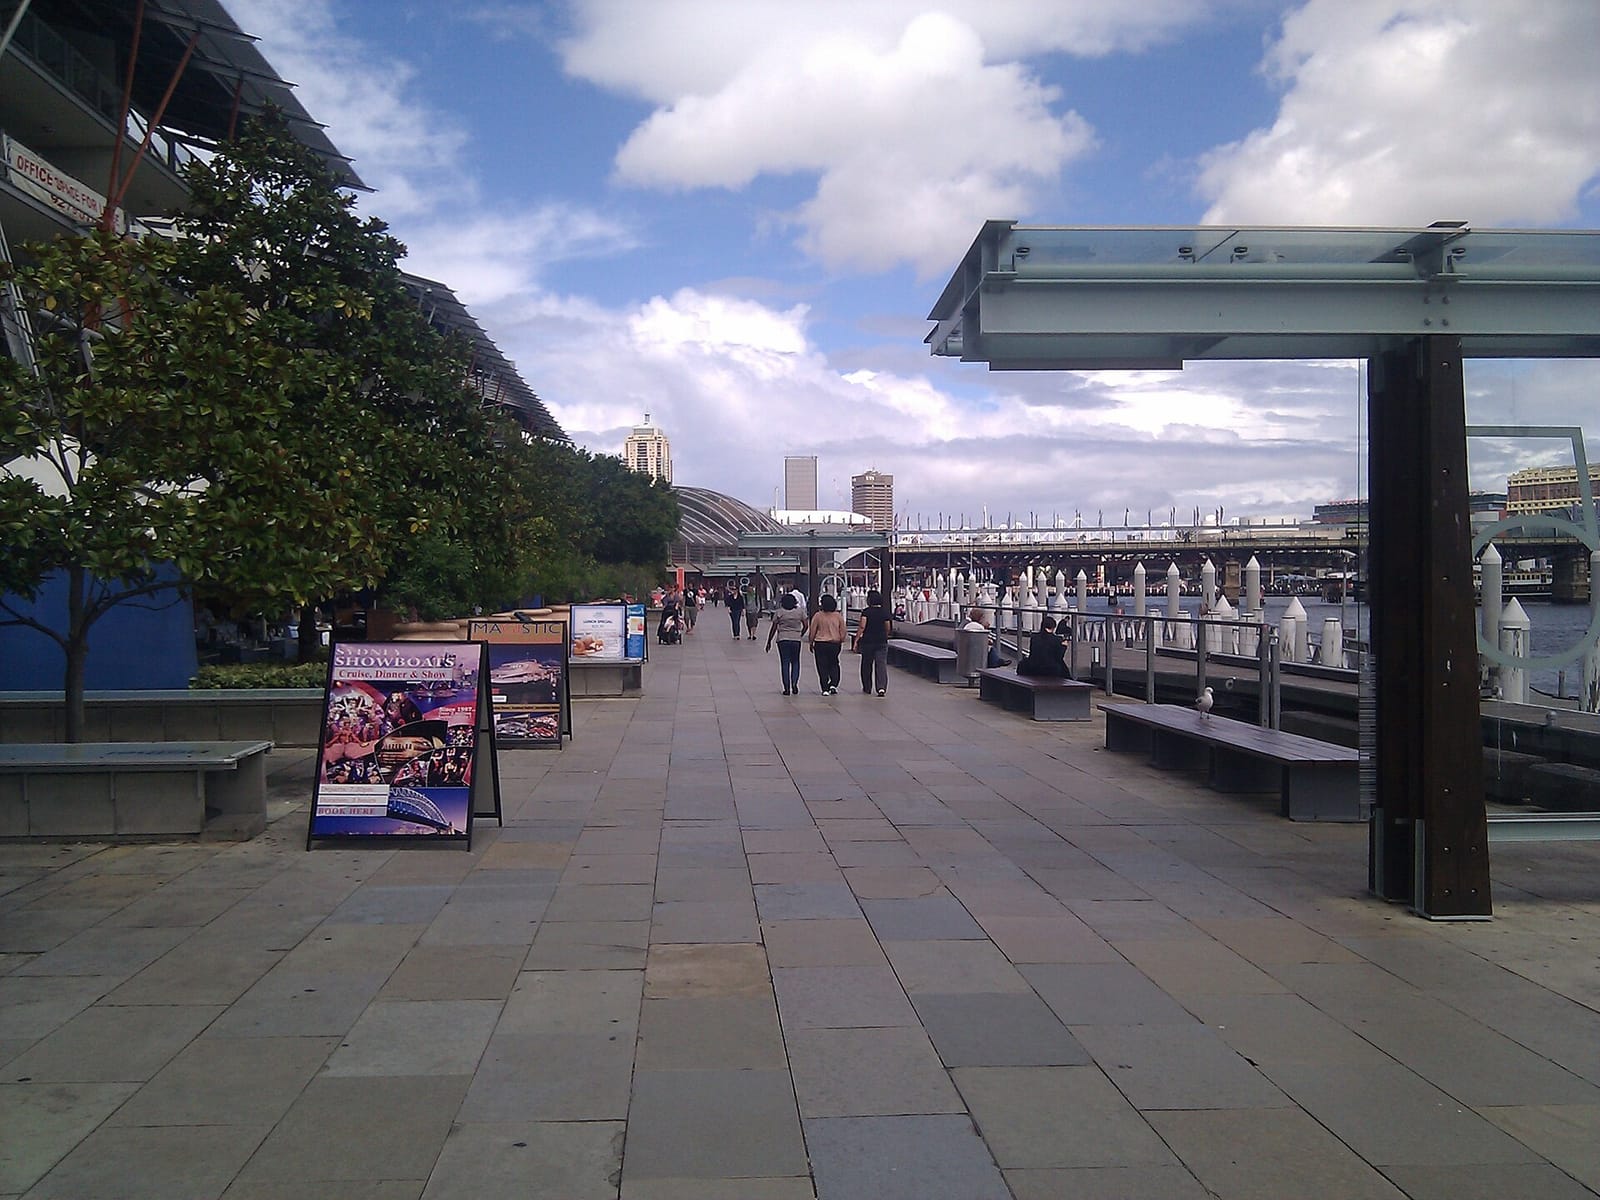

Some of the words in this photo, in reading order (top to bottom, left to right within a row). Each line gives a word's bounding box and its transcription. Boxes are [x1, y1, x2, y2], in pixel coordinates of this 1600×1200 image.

[16, 155, 53, 186] OFFICE
[81, 193, 98, 211] FOR
[335, 647, 401, 656] SYDNEY
[334, 656, 455, 667] SHOWBOATS
[339, 669, 373, 679] Cruise,
[375, 670, 407, 678] Dinner
[410, 670, 418, 678] &
[421, 670, 447, 678] Show
[318, 807, 345, 815] BOOK
[349, 807, 376, 815] HERE
